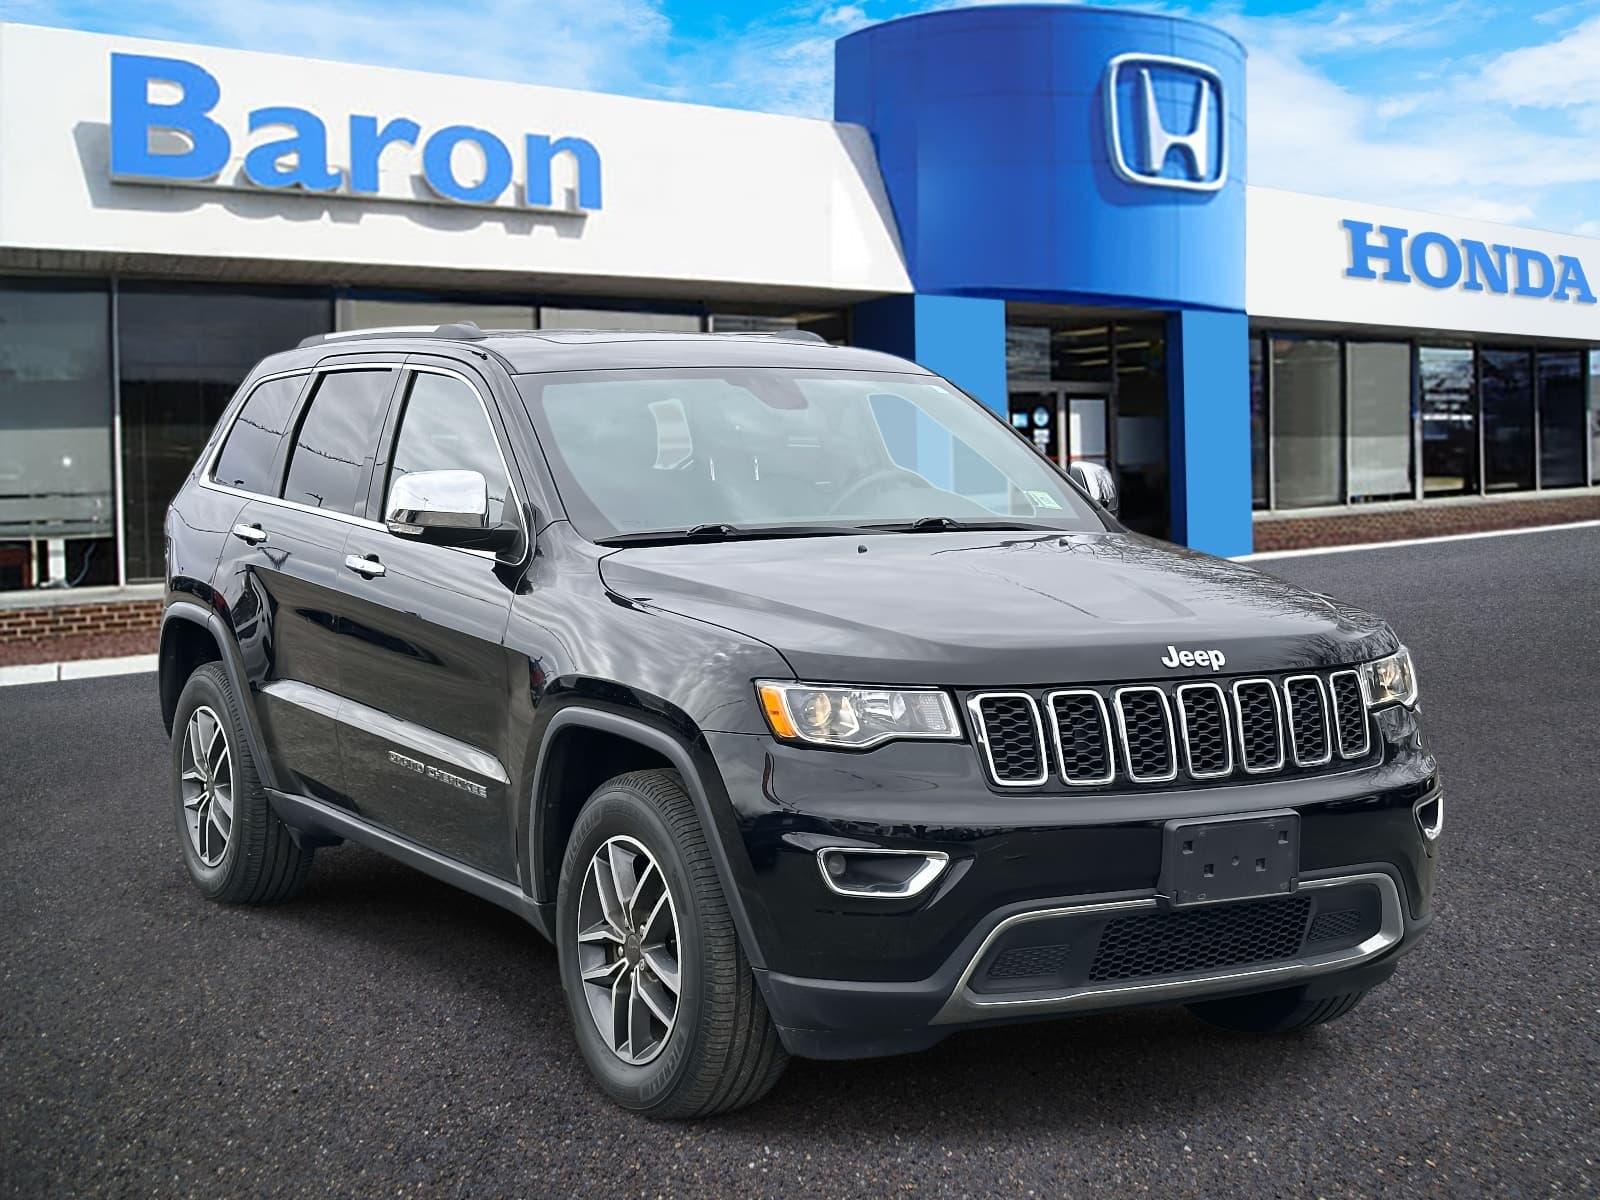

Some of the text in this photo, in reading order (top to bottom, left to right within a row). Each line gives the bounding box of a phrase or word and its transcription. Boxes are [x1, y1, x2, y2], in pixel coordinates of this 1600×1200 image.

[110, 52, 603, 210] Baron
[1342, 218, 1598, 304] HONDA
[1161, 645, 1226, 671] Jeep
